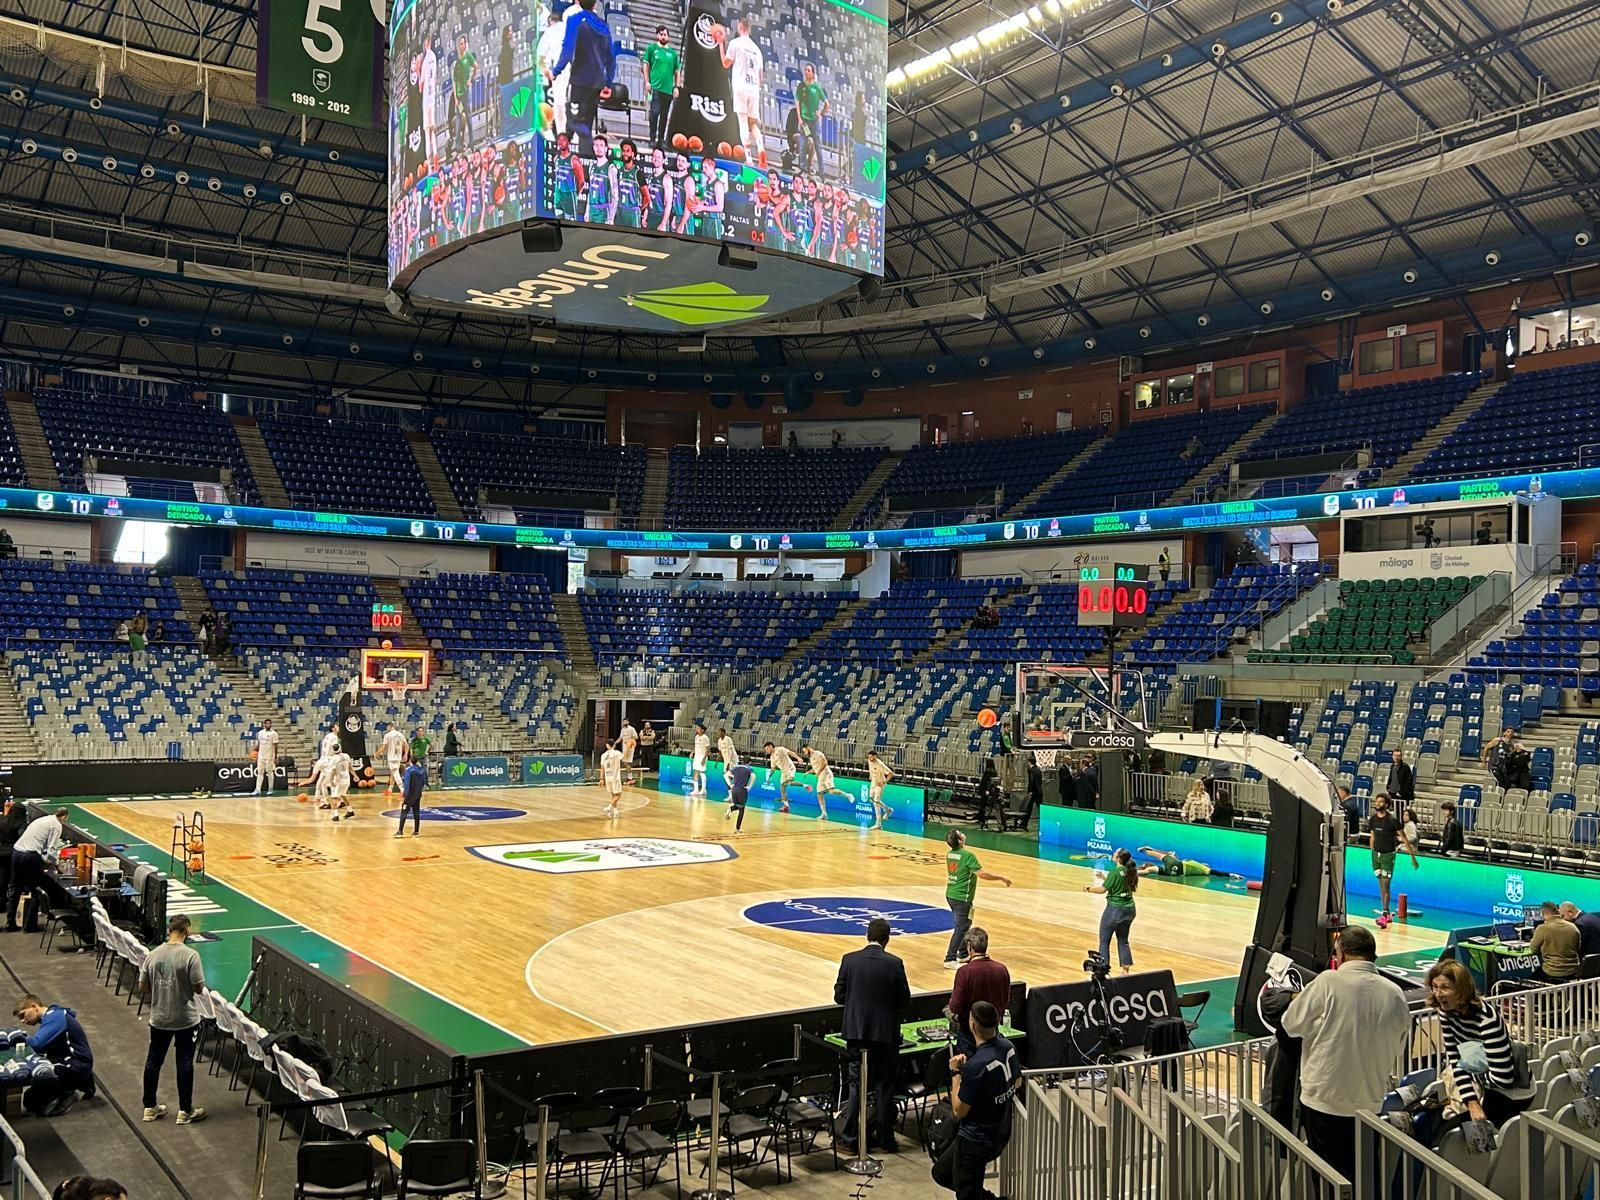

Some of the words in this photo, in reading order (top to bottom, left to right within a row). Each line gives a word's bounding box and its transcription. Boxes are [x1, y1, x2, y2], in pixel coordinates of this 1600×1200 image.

[302, 0, 344, 63] 5
[291, 92, 316, 107] 1999
[327, 101, 351, 115] 2012
[690, 94, 727, 121] Risi
[735, 183, 745, 192] Q1
[729, 215, 750, 225] FALTAS
[751, 230, 765, 243] 0.1
[465, 245, 670, 309] Unicaja
[1460, 482, 1499, 494] PARTIDO
[71, 500, 90, 514] 10
[167, 504, 200, 513] PARTIDO
[1222, 502, 1255, 514] UNICAJA
[1355, 497, 1375, 509] 10
[167, 511, 203, 520] DEDICADO
[315, 512, 348, 524] UNICAJA
[1094, 515, 1120, 524] PARTIDO
[1237, 512, 1250, 521] SAN
[1250, 511, 1270, 520] PABLO
[1271, 509, 1298, 519] BURGOS
[437, 527, 454, 539] 10
[516, 529, 544, 537] PARTIDO
[1026, 526, 1039, 539] 10
[1094, 523, 1124, 532] DEDICADO
[516, 535, 548, 543] DEDICADO
[643, 533, 673, 541] UNICAJA
[753, 538, 769, 550] 10
[1380, 557, 1413, 568] málaga
[1081, 567, 1099, 580] 0.0
[1117, 567, 1135, 580] 0.0
[1079, 586, 1113, 613] 0.0
[1115, 586, 1147, 614] 0.0
[381, 614, 402, 627] 0.0
[1089, 733, 1135, 748] endesa
[218, 764, 286, 780] enda
[469, 766, 504, 777] Unicaja
[546, 764, 580, 775] Unicaja
[1087, 841, 1113, 851] PIZARRA
[1498, 954, 1540, 973] Unicaja
[1046, 989, 1169, 1034] endesa
